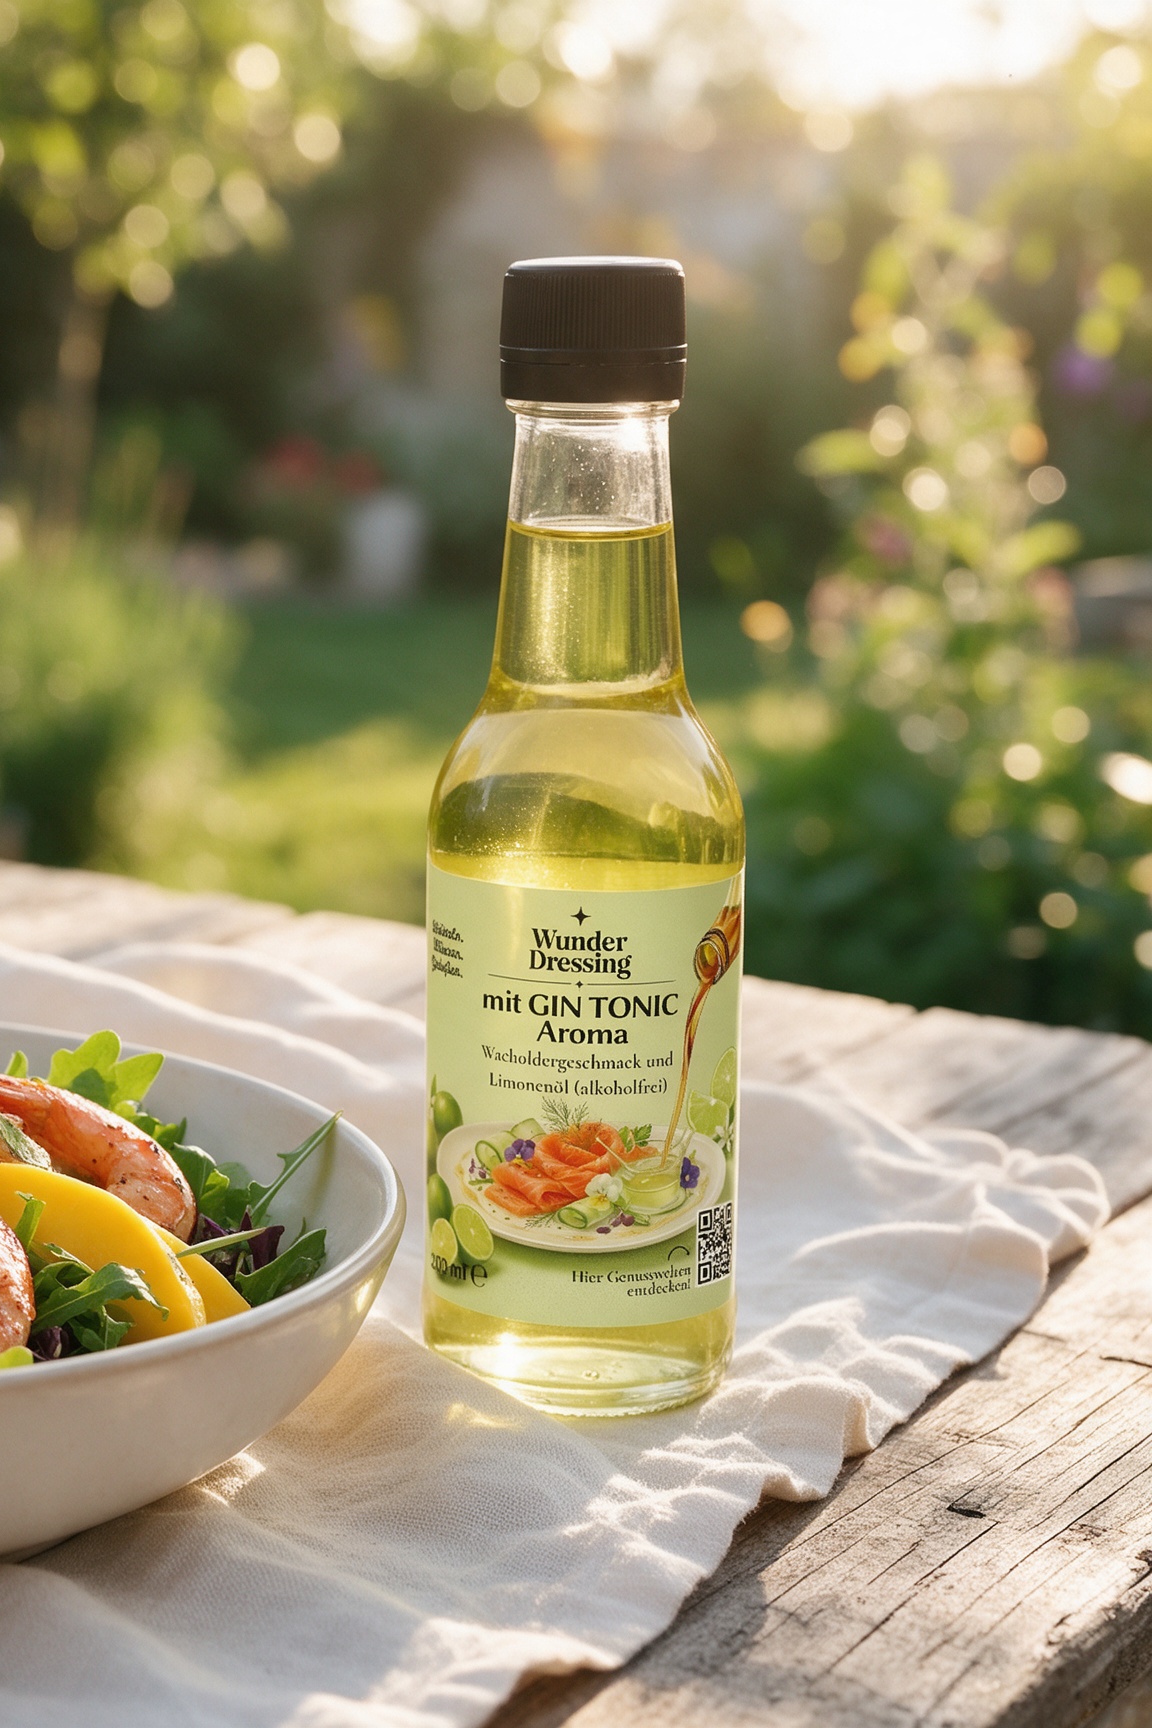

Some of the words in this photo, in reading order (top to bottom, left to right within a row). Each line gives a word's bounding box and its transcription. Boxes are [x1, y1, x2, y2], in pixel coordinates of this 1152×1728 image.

[531, 928, 628, 952] Wunder
[529, 950, 632, 980] Dressing
[482, 990, 522, 1014] mit
[528, 993, 582, 1018] GIN
[589, 993, 679, 1018] TONIC
[536, 1020, 629, 1045] Aroma
[481, 1044, 642, 1073] Wacholdergeschmack
[647, 1051, 674, 1068] und
[489, 1072, 569, 1095] Limonenöl
[574, 1077, 668, 1097] (alkoholfrei)
[572, 1270, 604, 1284] Hier
[627, 1279, 692, 1297] entdecken!
